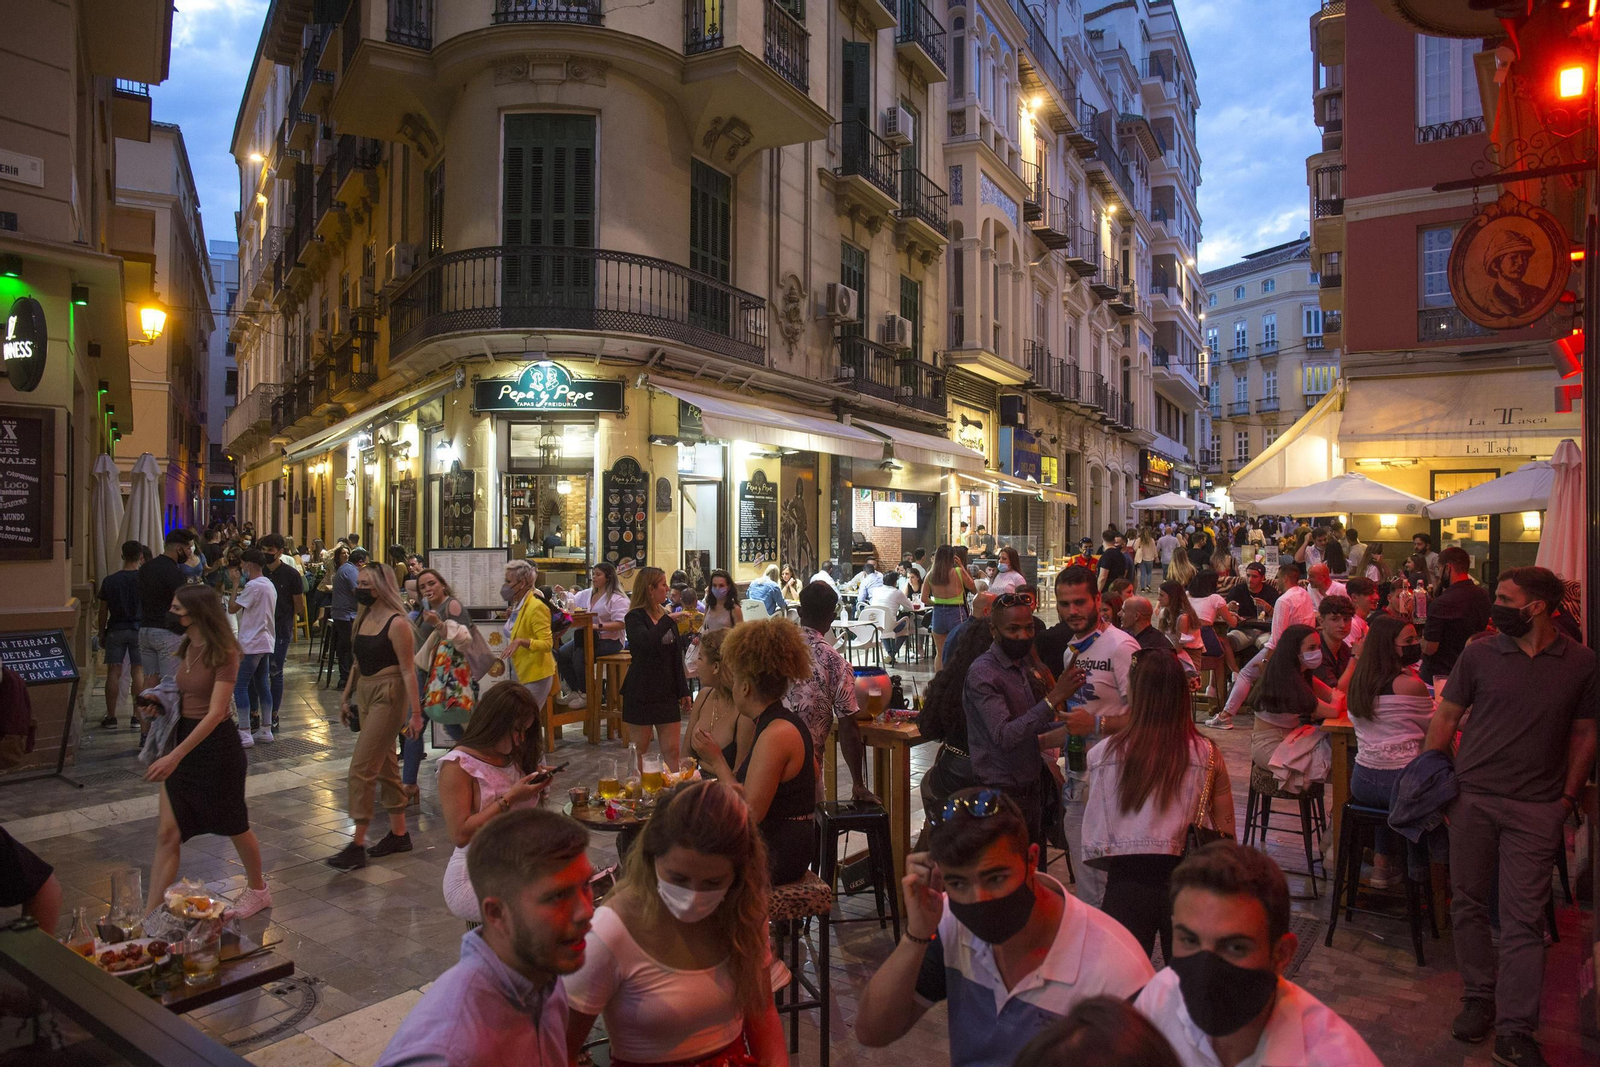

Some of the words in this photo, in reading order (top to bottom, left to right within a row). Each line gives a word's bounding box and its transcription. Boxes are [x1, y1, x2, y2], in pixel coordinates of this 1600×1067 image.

[498, 384, 535, 403] Pepa
[535, 390, 550, 408] y
[553, 384, 594, 403] Pepe
[1469, 418, 1485, 426] La
[1493, 407, 1548, 425] Tasca
[1466, 444, 1479, 454] La
[1484, 440, 1518, 453] Tasca
[10, 636, 58, 648] TERRAZA
[2, 648, 42, 660] DETRÁS
[5, 661, 51, 672] TERRACE
[53, 659, 66, 668] AT
[29, 670, 57, 681] BACK
